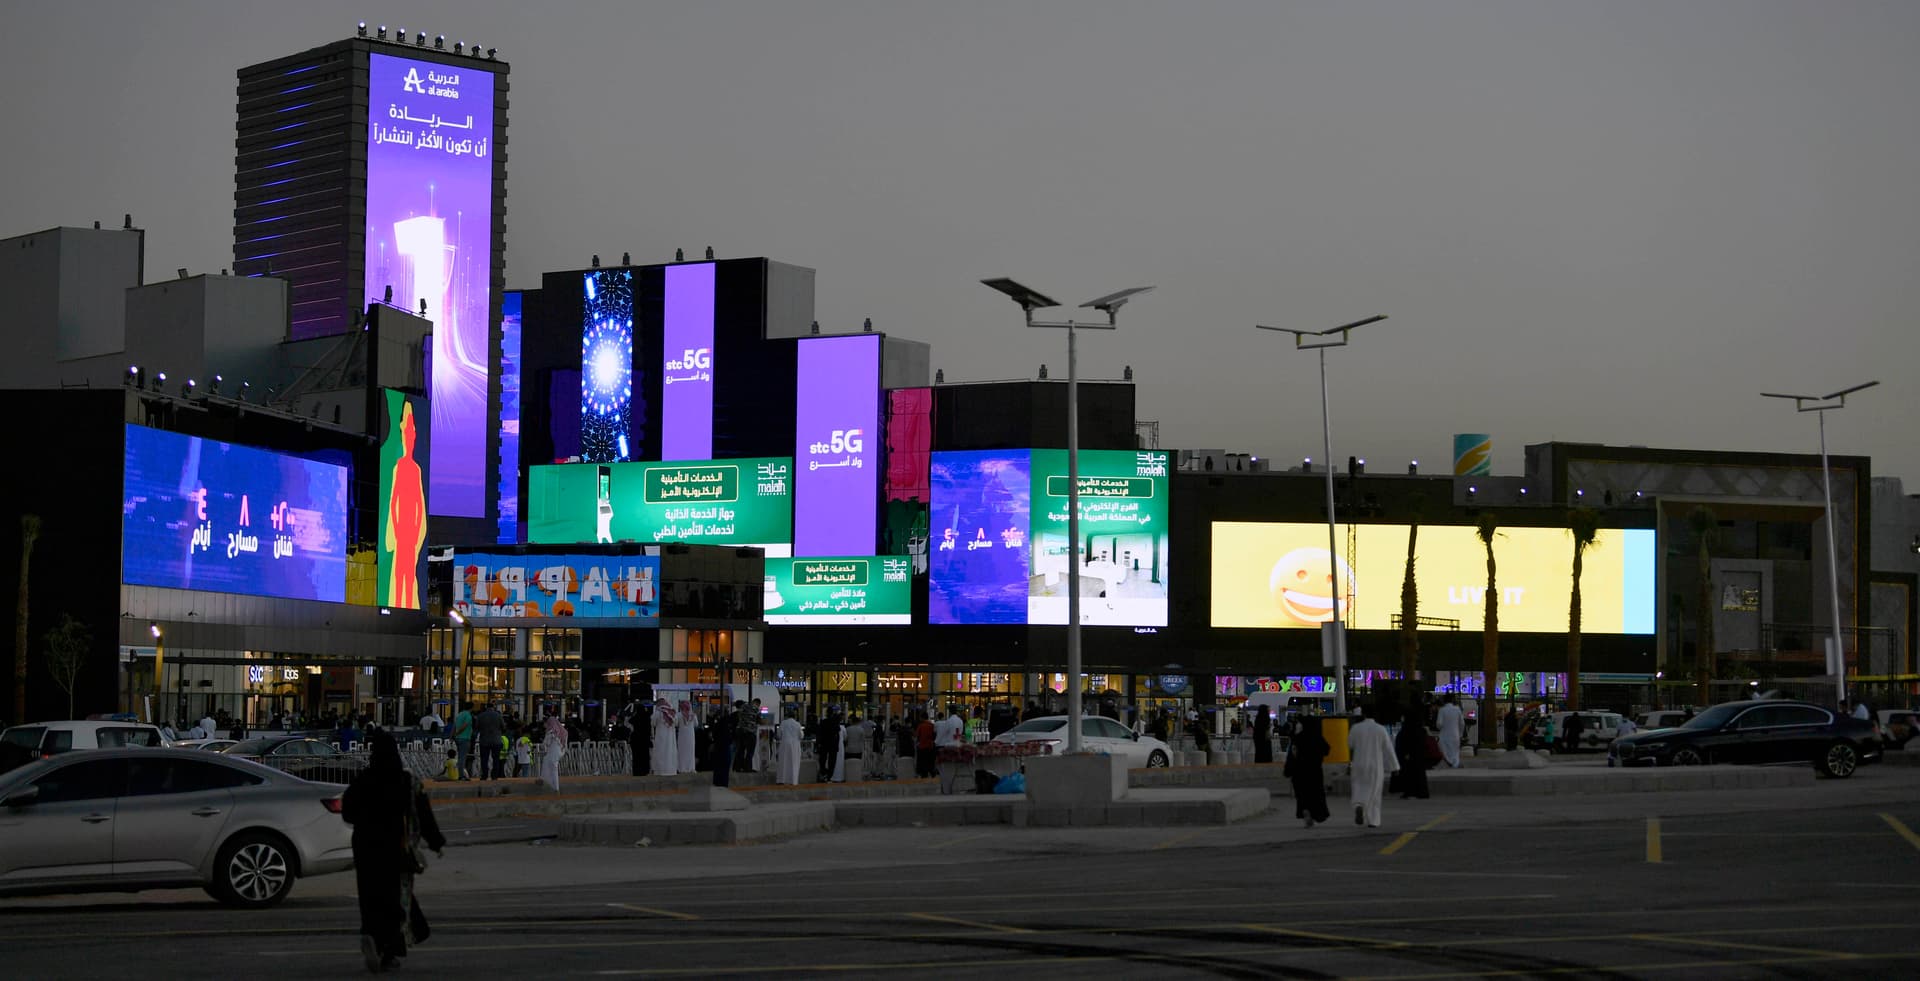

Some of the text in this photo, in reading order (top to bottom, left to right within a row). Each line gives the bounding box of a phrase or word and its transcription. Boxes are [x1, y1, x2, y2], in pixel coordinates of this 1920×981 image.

[428, 70, 460, 85] العربية
[415, 130, 443, 150] الأكثر
[446, 137, 472, 155] تكون
[474, 137, 487, 157] أن
[666, 348, 710, 370] stc 5G
[809, 429, 863, 454] stc 5G
[690, 508, 717, 519] الخدمة
[718, 508, 734, 520] جهاز
[190, 520, 212, 554] أيام
[678, 522, 703, 538] التأمين
[227, 530, 258, 559] مسارح
[1448, 586, 1488, 604] LIV
